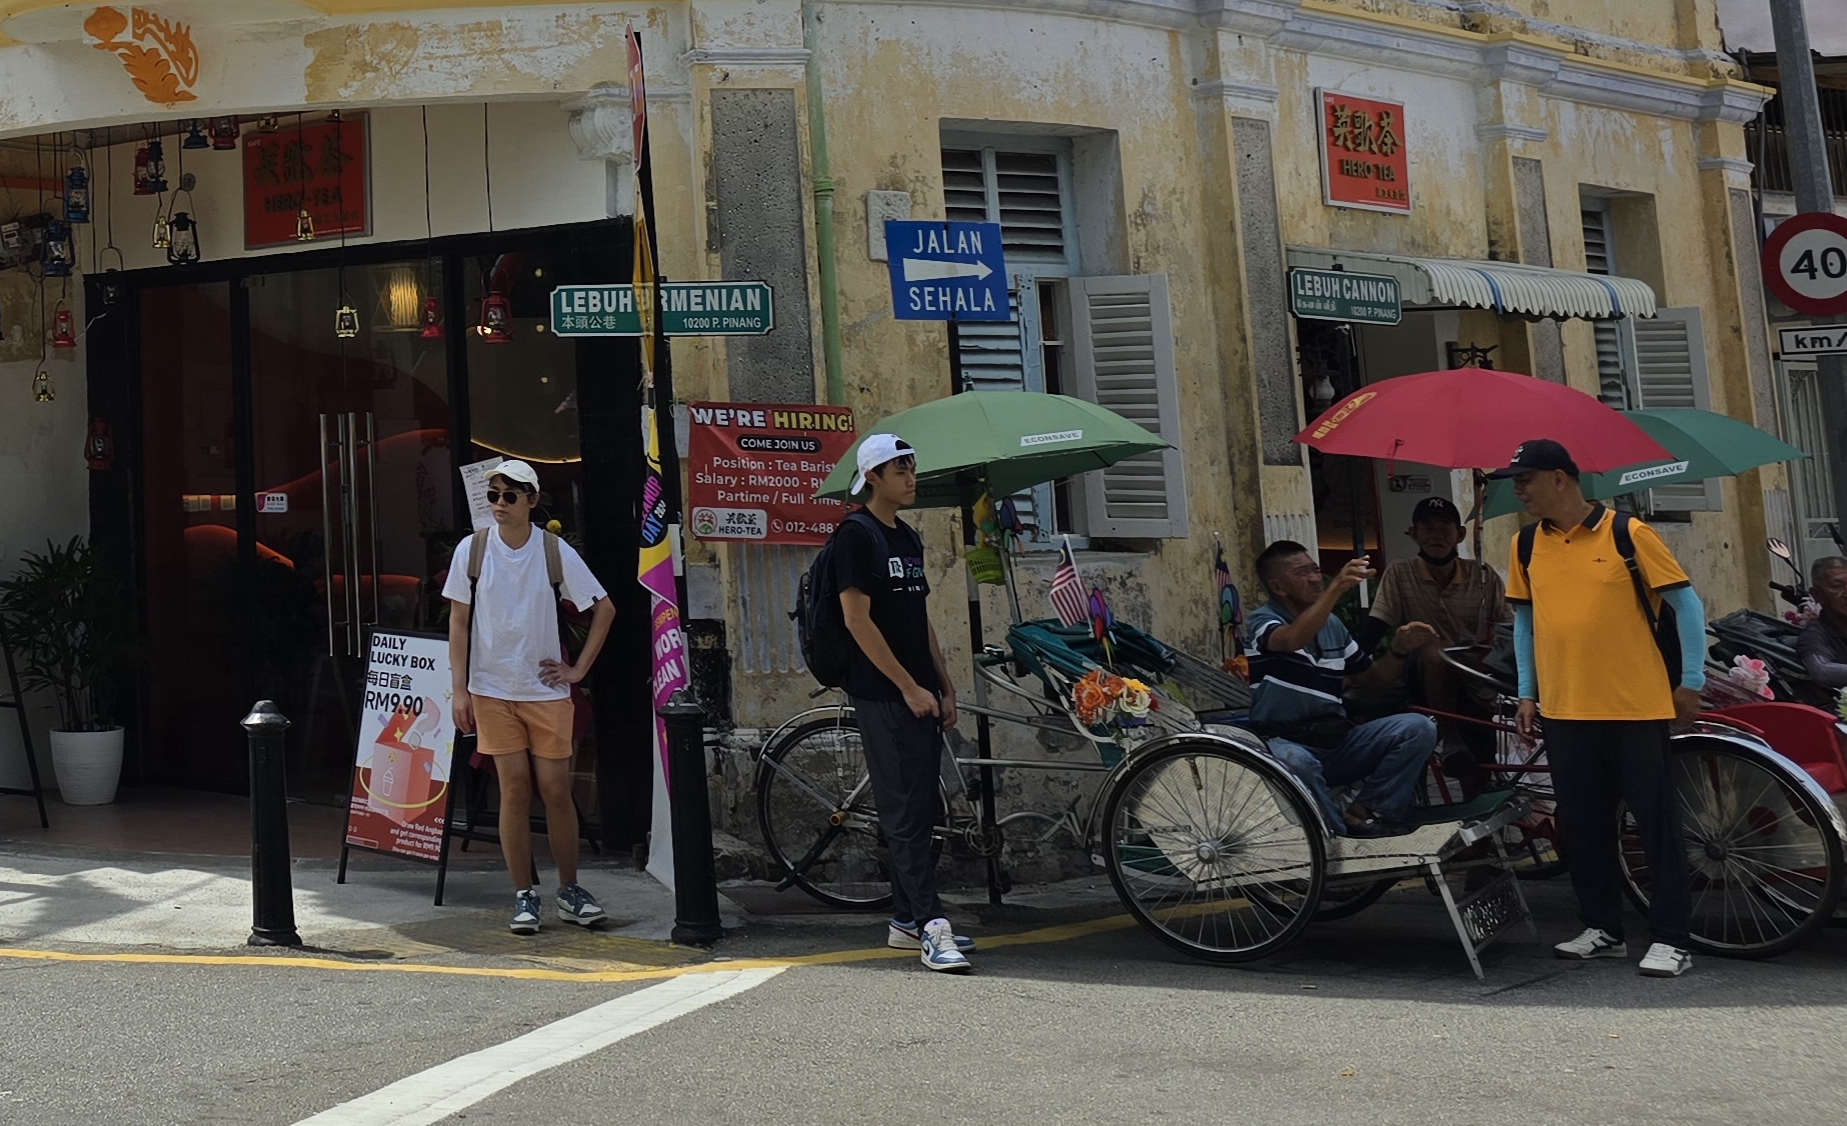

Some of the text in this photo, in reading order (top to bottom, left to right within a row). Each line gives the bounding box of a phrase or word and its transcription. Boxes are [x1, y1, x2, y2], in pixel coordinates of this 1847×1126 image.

[1333, 104, 1403, 157] 英歌茶
[913, 229, 983, 254] JALAN
[1790, 246, 1847, 280] 40
[909, 286, 996, 312] SEHALA
[1297, 274, 1396, 304] LEBUH CANNON
[561, 288, 761, 313] LEBUH RMENIAN
[1351, 305, 1367, 317] 10200
[1373, 307, 1397, 319] PINANG
[562, 315, 617, 330] 本頭公巷
[683, 316, 762, 329] 10200 P. PINANG
[1794, 331, 1847, 349] km/
[691, 407, 853, 432] WE'RE HIRING!
[740, 438, 816, 451] COME JOIN US
[1024, 431, 1080, 445] ECONSAVE
[713, 456, 765, 471] Position
[775, 459, 798, 472] Tea
[800, 460, 837, 473] Barist
[1624, 464, 1684, 482] ECONSAVE
[695, 472, 738, 487] Salary
[748, 476, 800, 488] RM2000
[641, 475, 662, 531] EANUP
[717, 490, 770, 504] Partime
[781, 492, 805, 504] Full
[641, 512, 664, 545] DAY
[718, 526, 762, 536] HERO-TEA
[785, 521, 835, 534] 012-488
[372, 635, 407, 651] DAILY
[370, 651, 436, 671] LUCKY BOX
[367, 670, 413, 691] 每日盲盒
[653, 658, 681, 700] CLEAN
[365, 690, 424, 717] RM9.90
